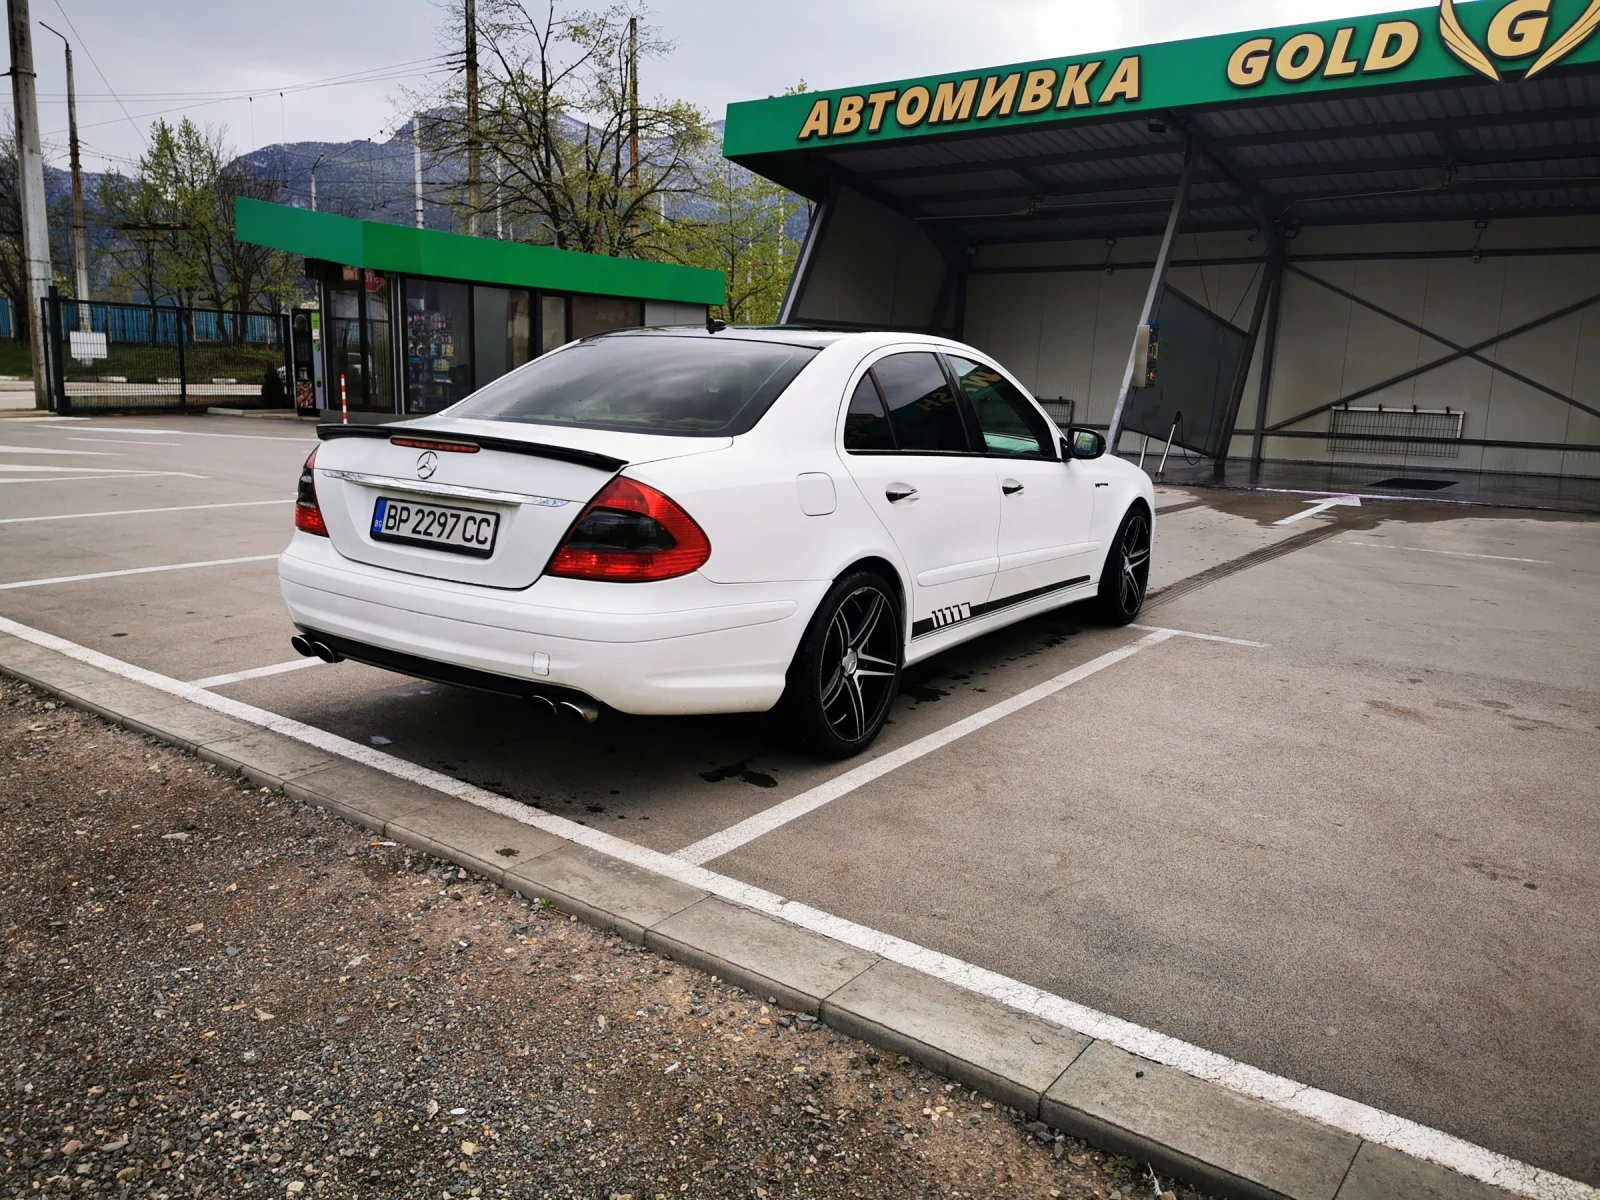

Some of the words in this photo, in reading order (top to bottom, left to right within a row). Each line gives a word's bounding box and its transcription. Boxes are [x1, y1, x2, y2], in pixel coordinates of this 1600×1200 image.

[1225, 19, 1421, 88] GOLD
[1486, 0, 1550, 58] G
[797, 55, 1141, 139] АВТОМИВКА
[385, 504, 411, 532] BP
[411, 508, 461, 540] 2297
[462, 515, 491, 545] CC
